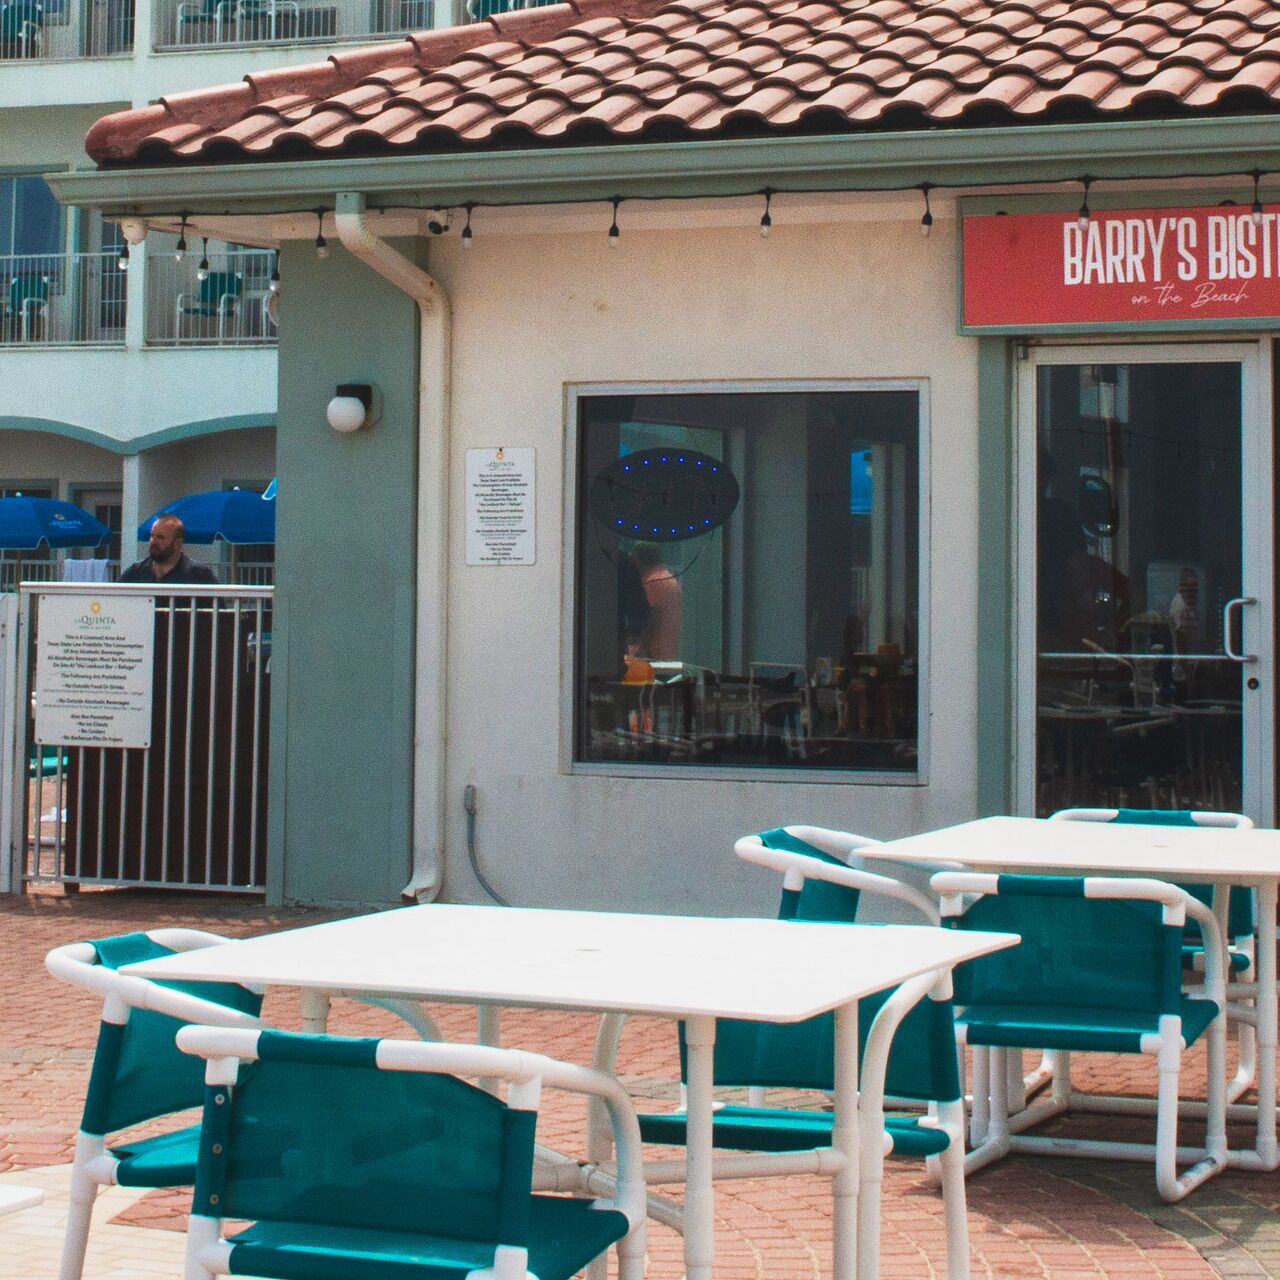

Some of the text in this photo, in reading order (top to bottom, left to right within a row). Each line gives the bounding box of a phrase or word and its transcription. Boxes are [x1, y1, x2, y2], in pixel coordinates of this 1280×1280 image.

[1062, 215, 1198, 286] BARRY'S
[1131, 281, 1250, 309] on the Beach
